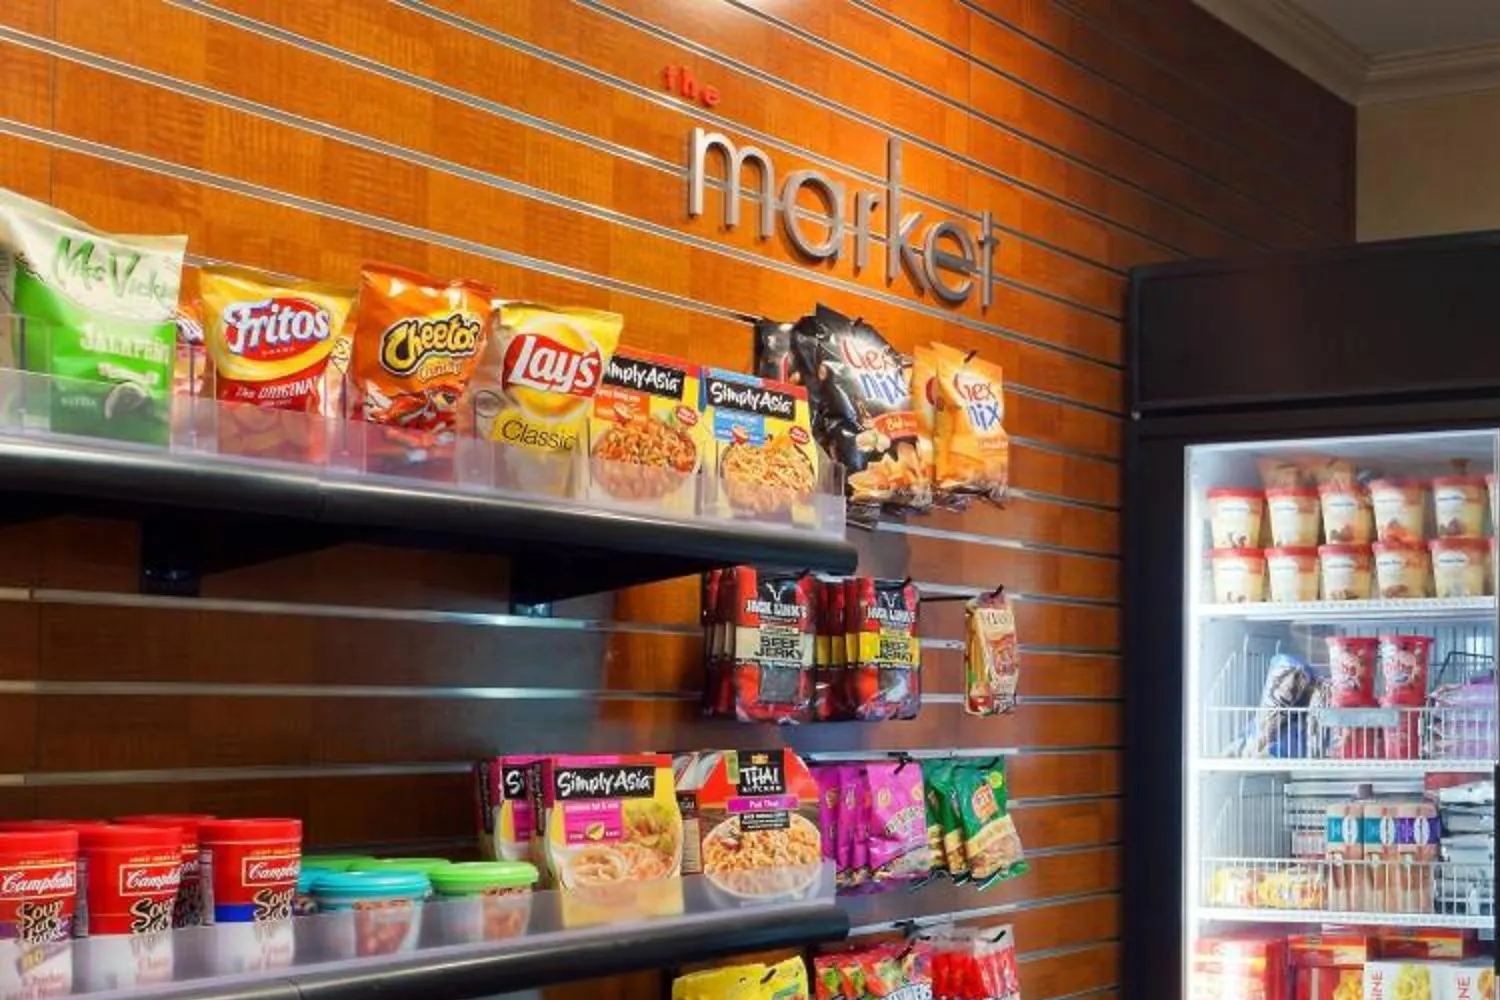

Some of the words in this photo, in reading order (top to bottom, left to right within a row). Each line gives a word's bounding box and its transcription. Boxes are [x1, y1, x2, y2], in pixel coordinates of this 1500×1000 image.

[661, 65, 721, 108] the
[688, 127, 998, 308] market
[222, 298, 331, 354] Fritos
[382, 313, 481, 375] Cheetos
[507, 334, 600, 395] Lay's
[501, 415, 577, 452] Classic
[754, 647, 805, 660] JERKY
[760, 635, 801, 648] BEEF
[740, 766, 780, 789] THAI
